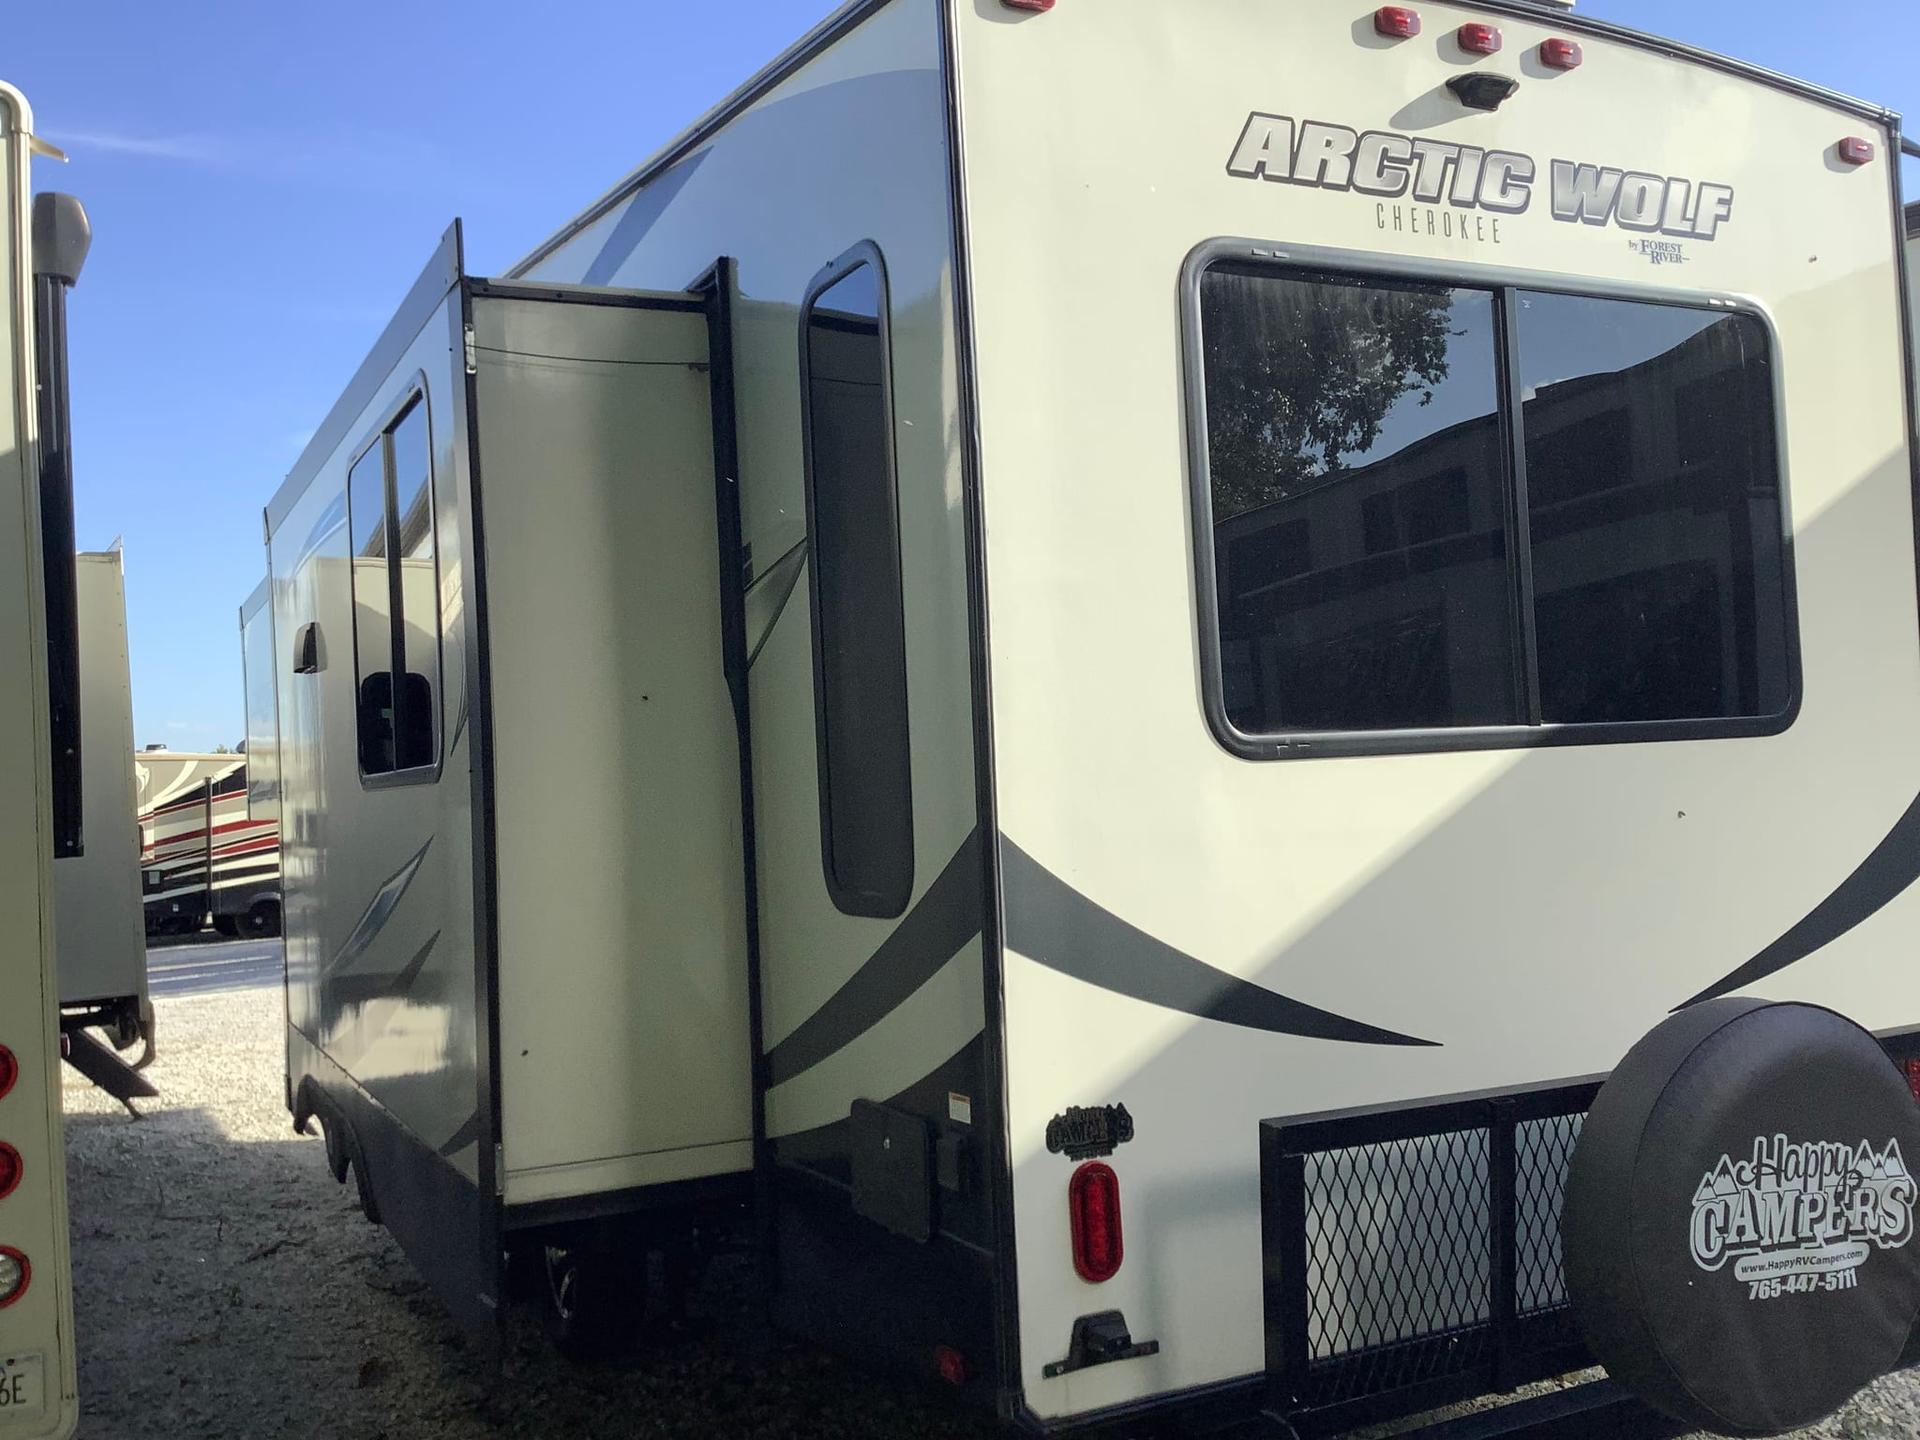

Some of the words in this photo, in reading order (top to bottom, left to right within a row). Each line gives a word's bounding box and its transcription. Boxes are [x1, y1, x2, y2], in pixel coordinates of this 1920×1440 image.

[1226, 111, 1536, 215] ARCTIC
[1550, 158, 1734, 241] WOLF
[1376, 203, 1501, 244] CHEROKEE
[1628, 239, 1639, 251] by
[1640, 238, 1682, 254] FOREST
[1650, 250, 1682, 265] RIVER
[1735, 1133, 1864, 1196] Happy
[1692, 1178, 1915, 1263] CAMPERS
[1741, 1250, 1863, 1274] www.HappyRVCampers.com
[1748, 1267, 1858, 1300] 765-447-5111
